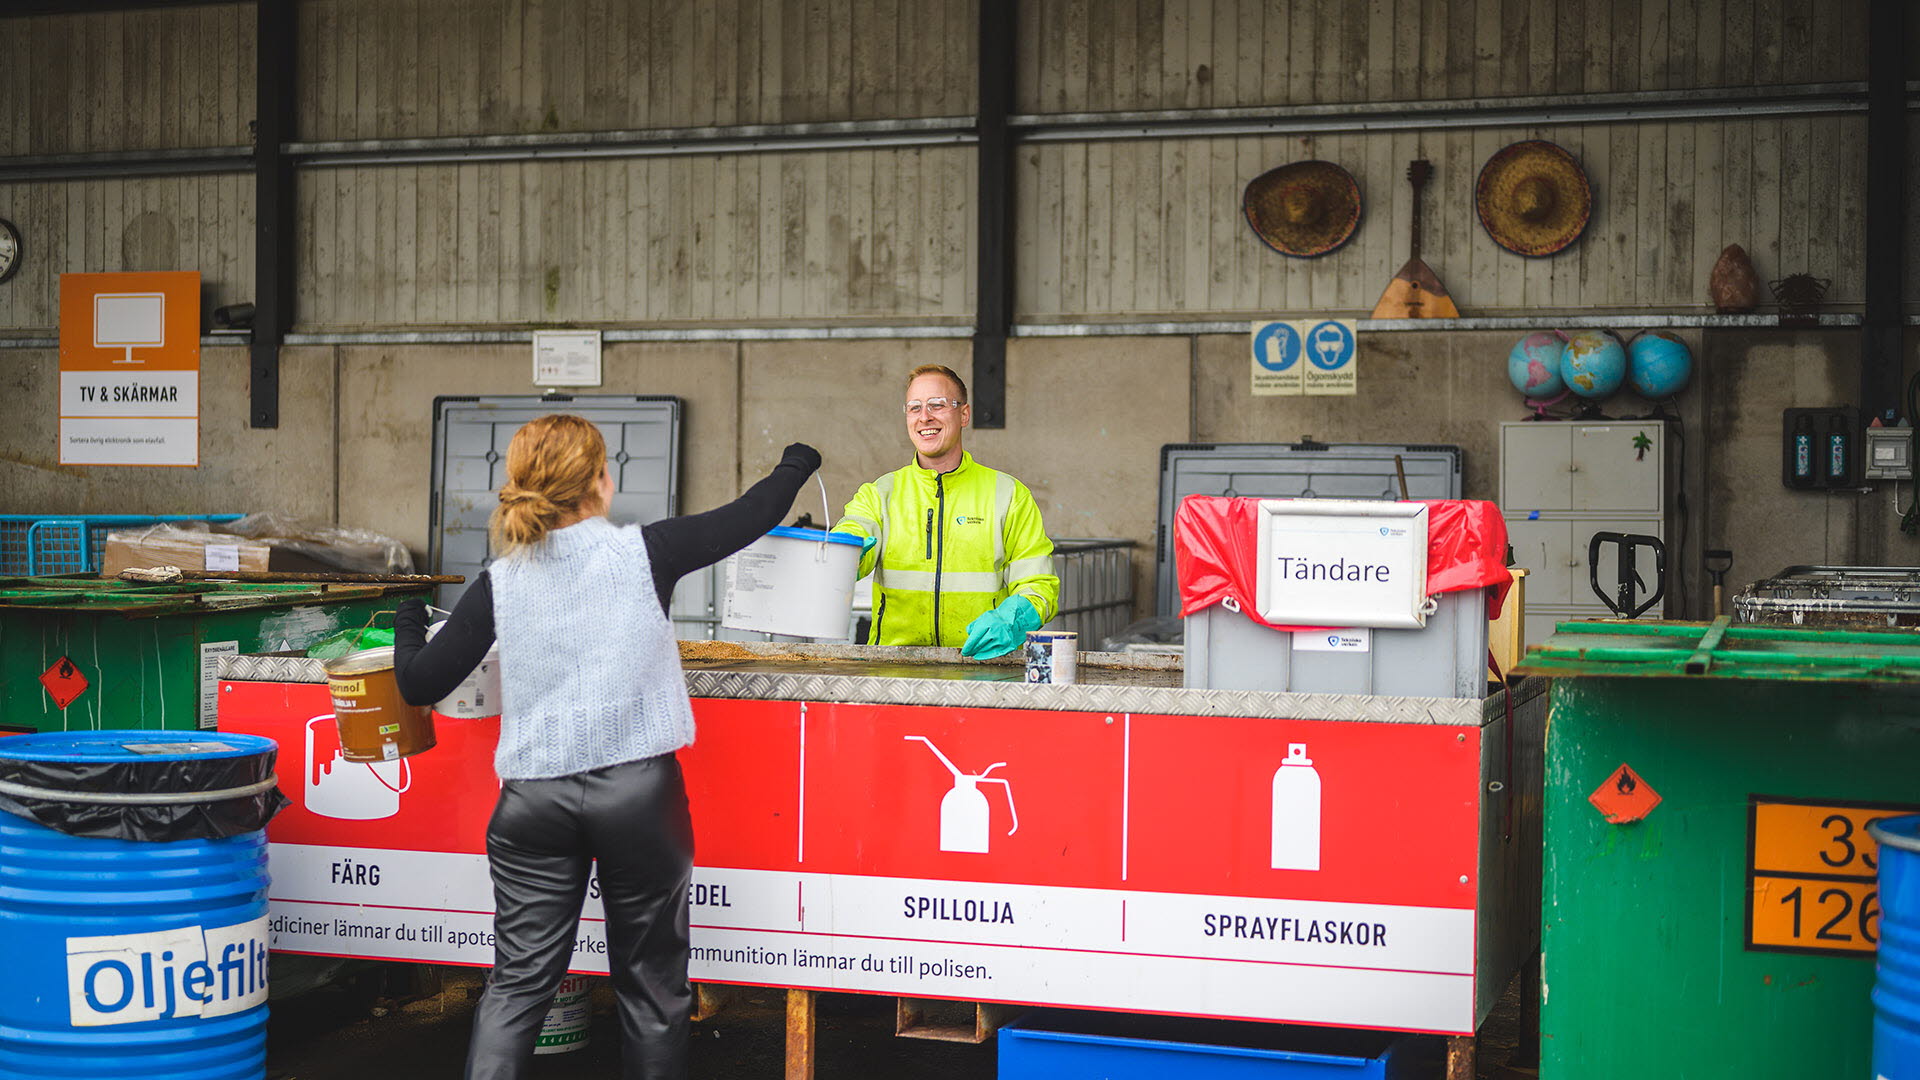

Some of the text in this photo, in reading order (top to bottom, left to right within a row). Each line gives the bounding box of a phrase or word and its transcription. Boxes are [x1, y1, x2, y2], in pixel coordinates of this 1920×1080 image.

[80, 382, 178, 402] TV & SKÄRMAR
[1277, 557, 1390, 582] Tändare
[331, 858, 381, 886] FÄRG
[904, 896, 1015, 924] SPILLOLJA
[1204, 913, 1387, 947] SPRAYFLASKOR
[268, 915, 330, 935] ediciner
[334, 919, 391, 939] lämnar
[395, 923, 416, 941] du
[421, 925, 443, 943] till
[447, 930, 496, 948] apote
[689, 946, 787, 966] mmunition
[793, 948, 856, 970] lämnar
[861, 953, 884, 972] du
[890, 955, 914, 974] till
[919, 958, 993, 980] polisen.
[83, 938, 269, 1019] Oljefilt
